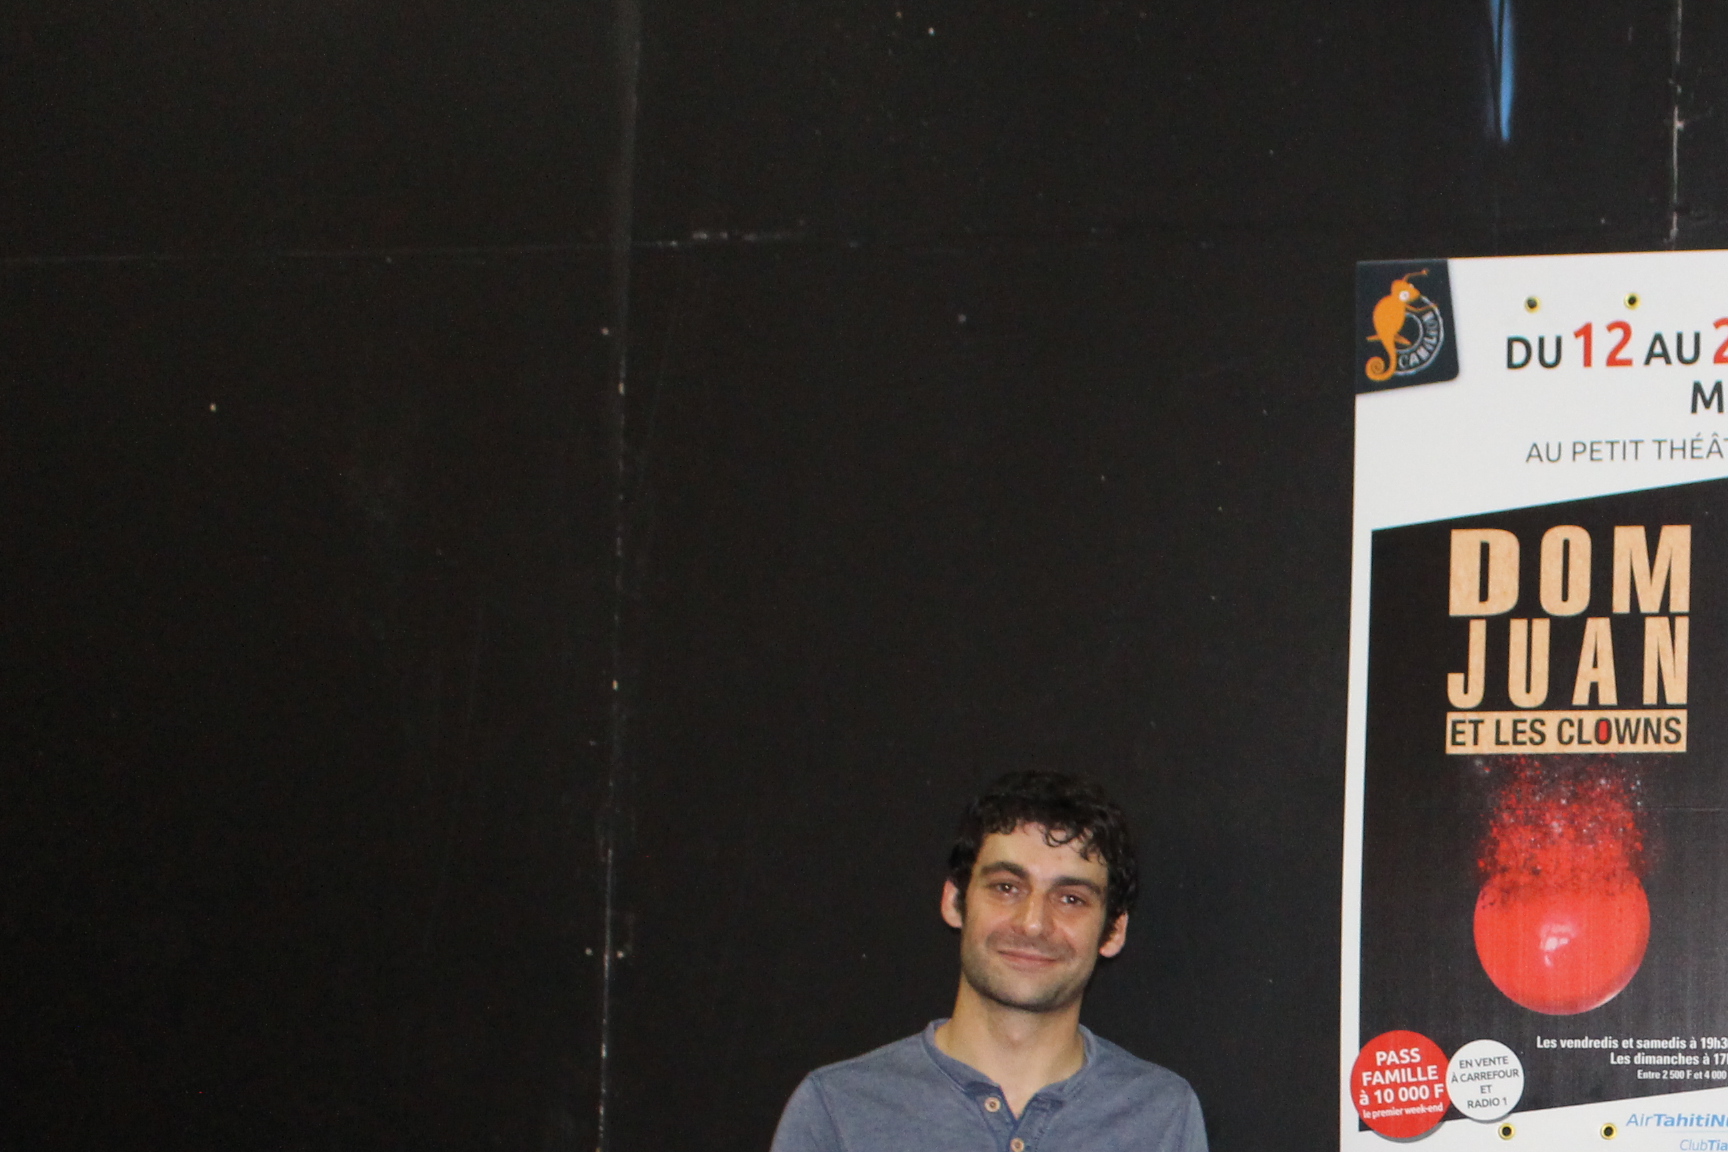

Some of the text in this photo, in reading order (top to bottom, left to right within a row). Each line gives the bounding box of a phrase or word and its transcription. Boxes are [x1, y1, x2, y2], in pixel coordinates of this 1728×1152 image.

[1506, 336, 1563, 369] DU
[1574, 321, 1634, 367] 12
[1644, 332, 1701, 365] AU
[1526, 442, 1561, 463] AU
[1573, 440, 1644, 462] PETIT
[1449, 525, 1692, 616] DOM
[1447, 616, 1690, 709] JUAN
[1451, 717, 1682, 746] ET LES CLOWNS
[1536, 1036, 1557, 1049] Les
[1560, 1036, 1619, 1049] vendredis
[1621, 1037, 1634, 1049] et
[1636, 1036, 1687, 1049] samedis
[1689, 1037, 1697, 1049] à
[1376, 1047, 1422, 1067] PASS
[1459, 1055, 1509, 1069] EN VENTE
[1610, 1052, 1631, 1065] Les
[1633, 1052, 1699, 1065] dimanches
[1702, 1053, 1711, 1065] à
[1361, 1065, 1439, 1087] FAMILLE
[1451, 1068, 1520, 1083] À CARREFOUR
[1637, 1070, 1661, 1080] Entre
[1662, 1070, 1669, 1079] 2
[1669, 1070, 1685, 1080] 500
[1686, 1070, 1693, 1079] F
[1693, 1070, 1703, 1080] et
[1704, 1070, 1710, 1079] 4
[1711, 1070, 1728, 1080] 000
[1359, 1084, 1445, 1106] à 10 000 F
[1480, 1084, 1493, 1094] ET
[1363, 1102, 1444, 1120] le premier week-end
[1467, 1096, 1508, 1109] RADIO 1
